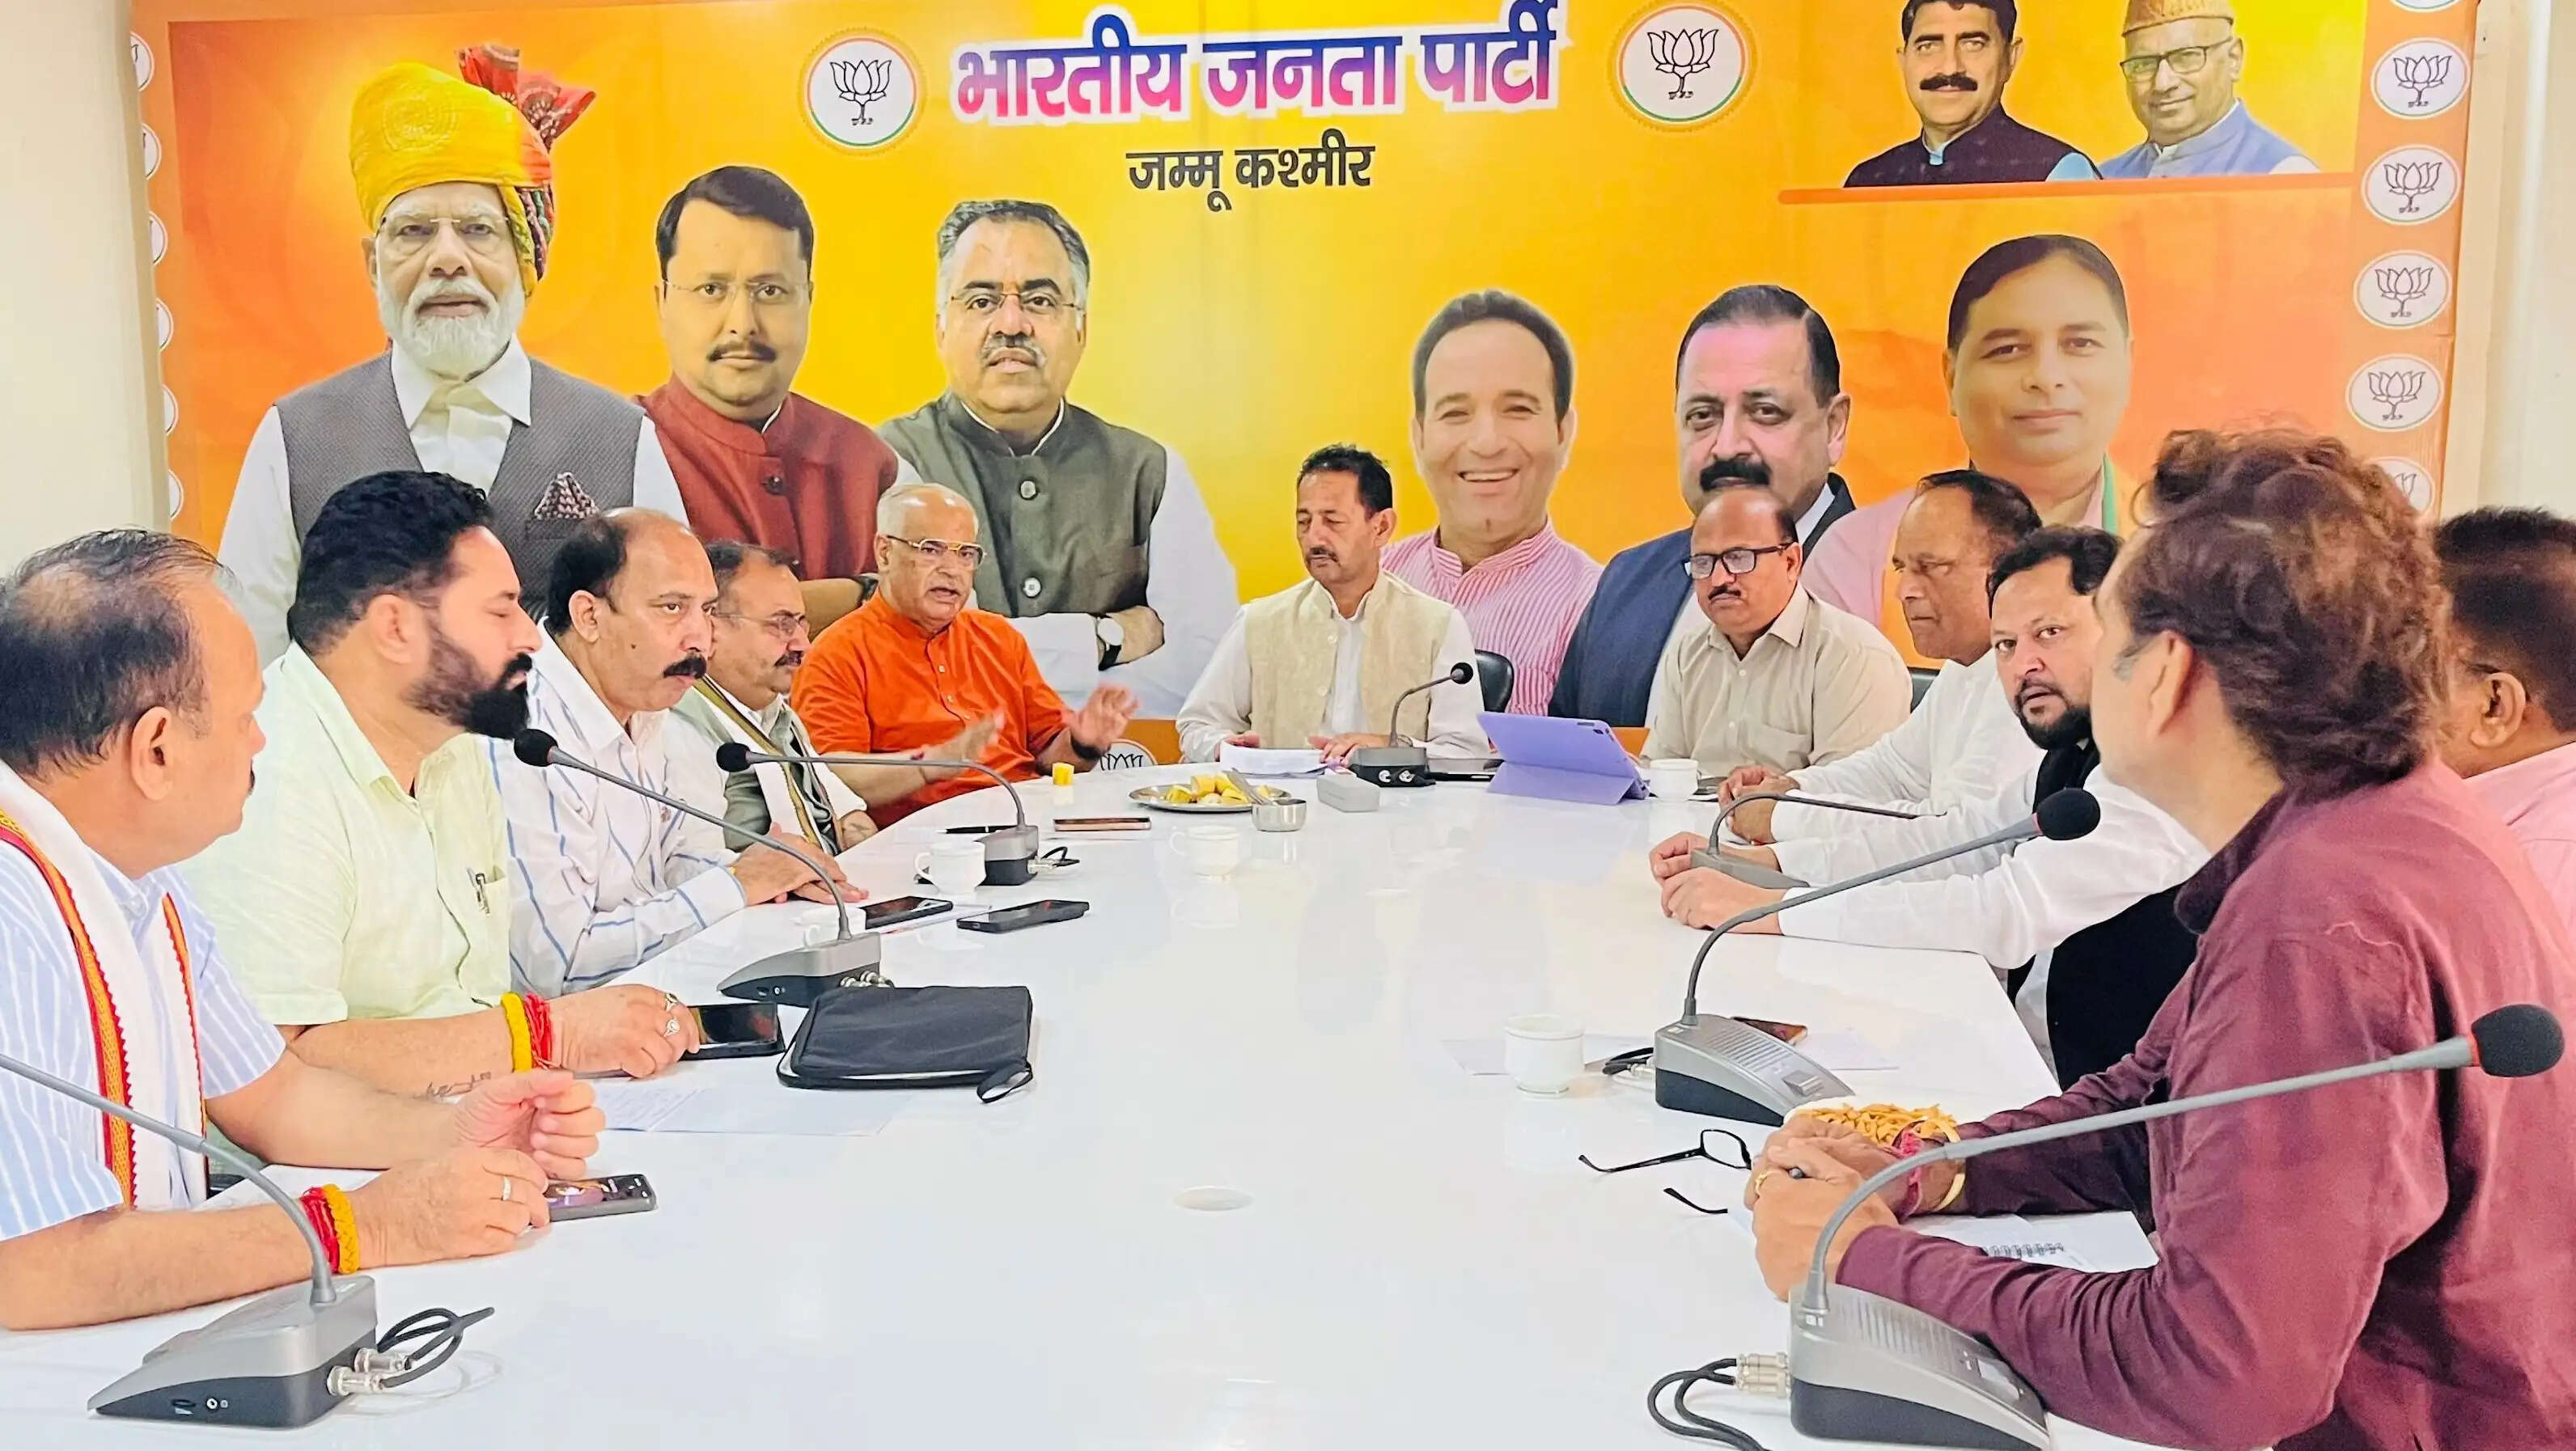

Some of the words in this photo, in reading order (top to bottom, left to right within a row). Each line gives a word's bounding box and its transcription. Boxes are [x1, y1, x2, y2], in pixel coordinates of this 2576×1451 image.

[958, 14, 1187, 118] भारतीय
[1203, 36, 1401, 109] जनता
[1421, 0, 1557, 103] पार्टी
[1126, 150, 1231, 212] जम्मू
[1235, 129, 1375, 189] कश्मीर
